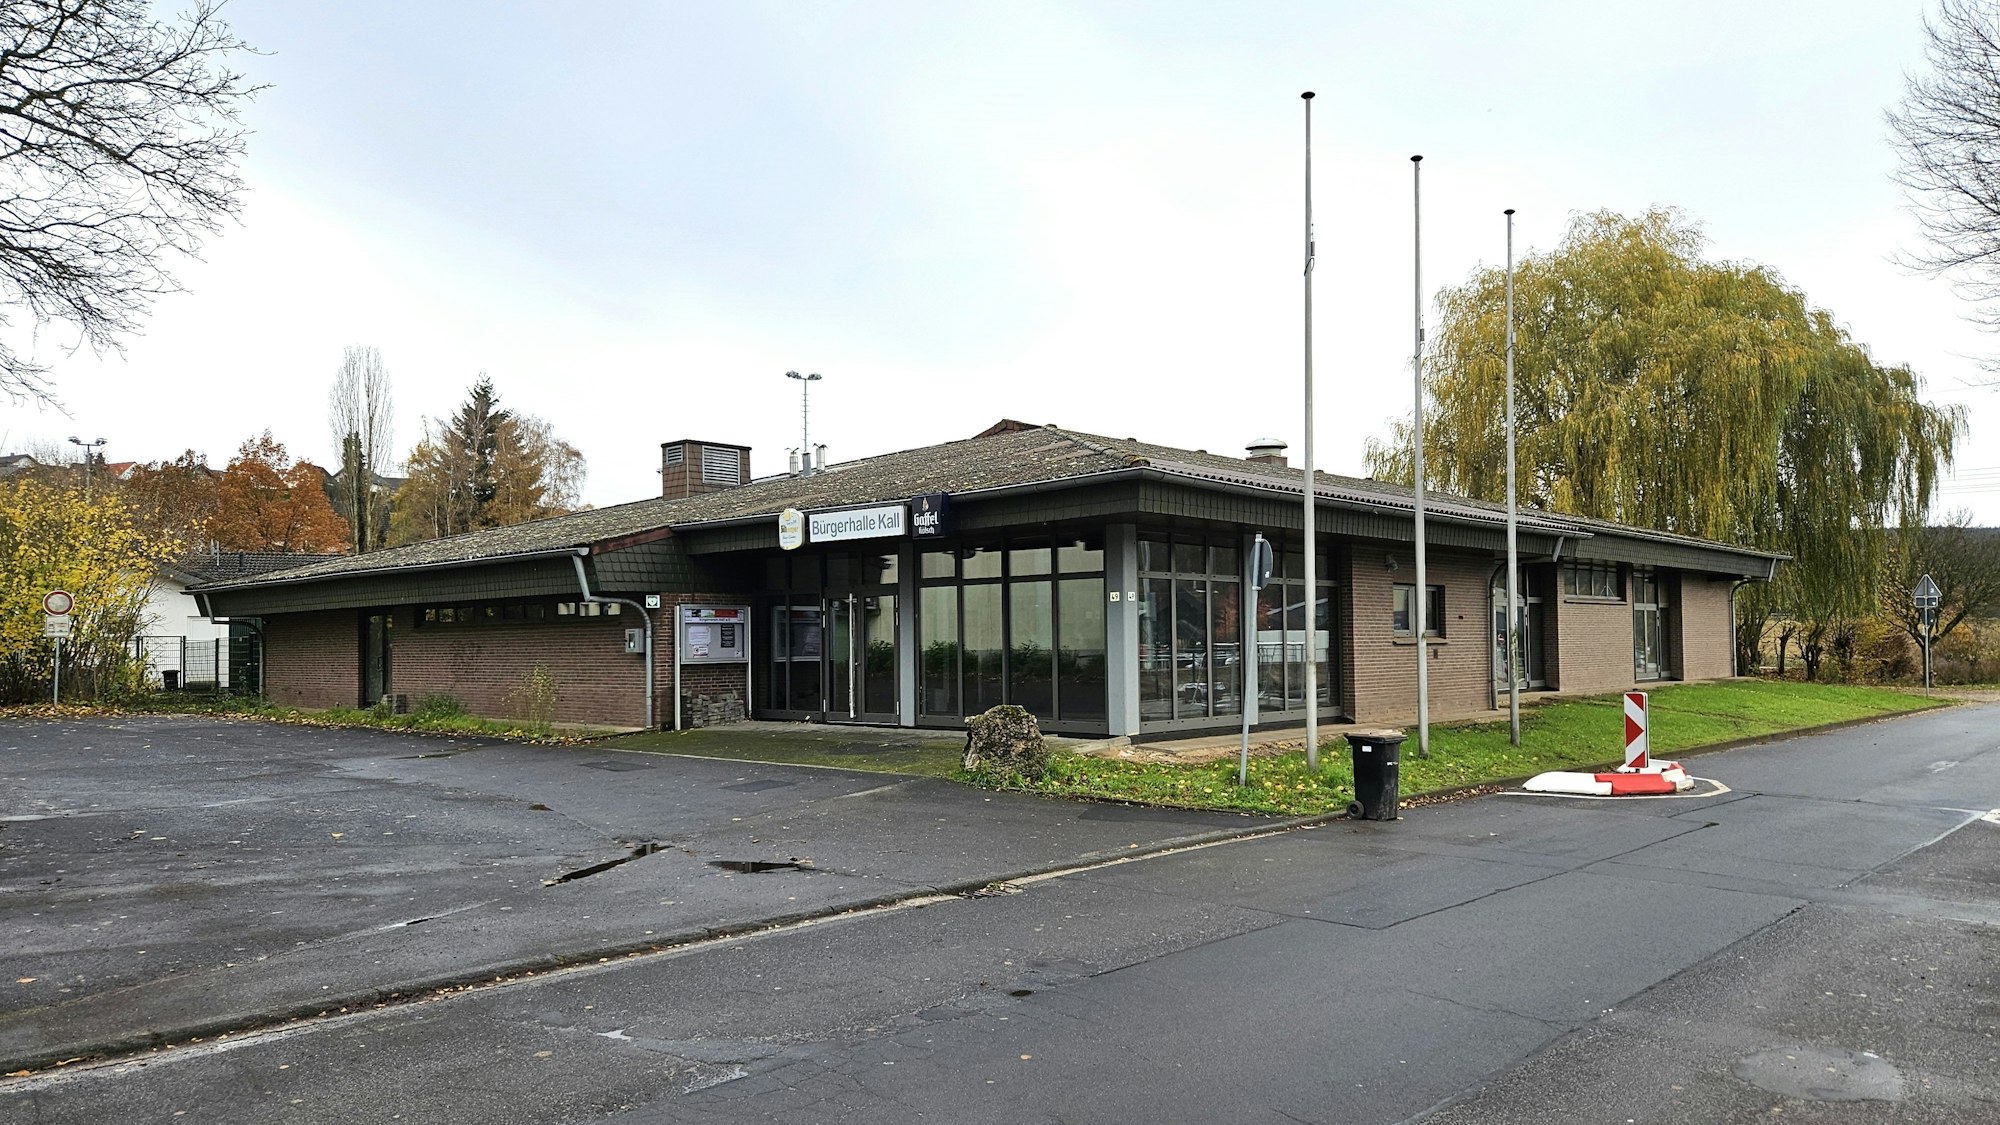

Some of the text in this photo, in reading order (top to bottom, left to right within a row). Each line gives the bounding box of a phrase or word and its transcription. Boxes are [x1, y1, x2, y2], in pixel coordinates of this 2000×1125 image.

[812, 515, 876, 538] Bürgerhalle
[878, 512, 900, 530] Kall
[913, 511, 939, 527] Gaffel
